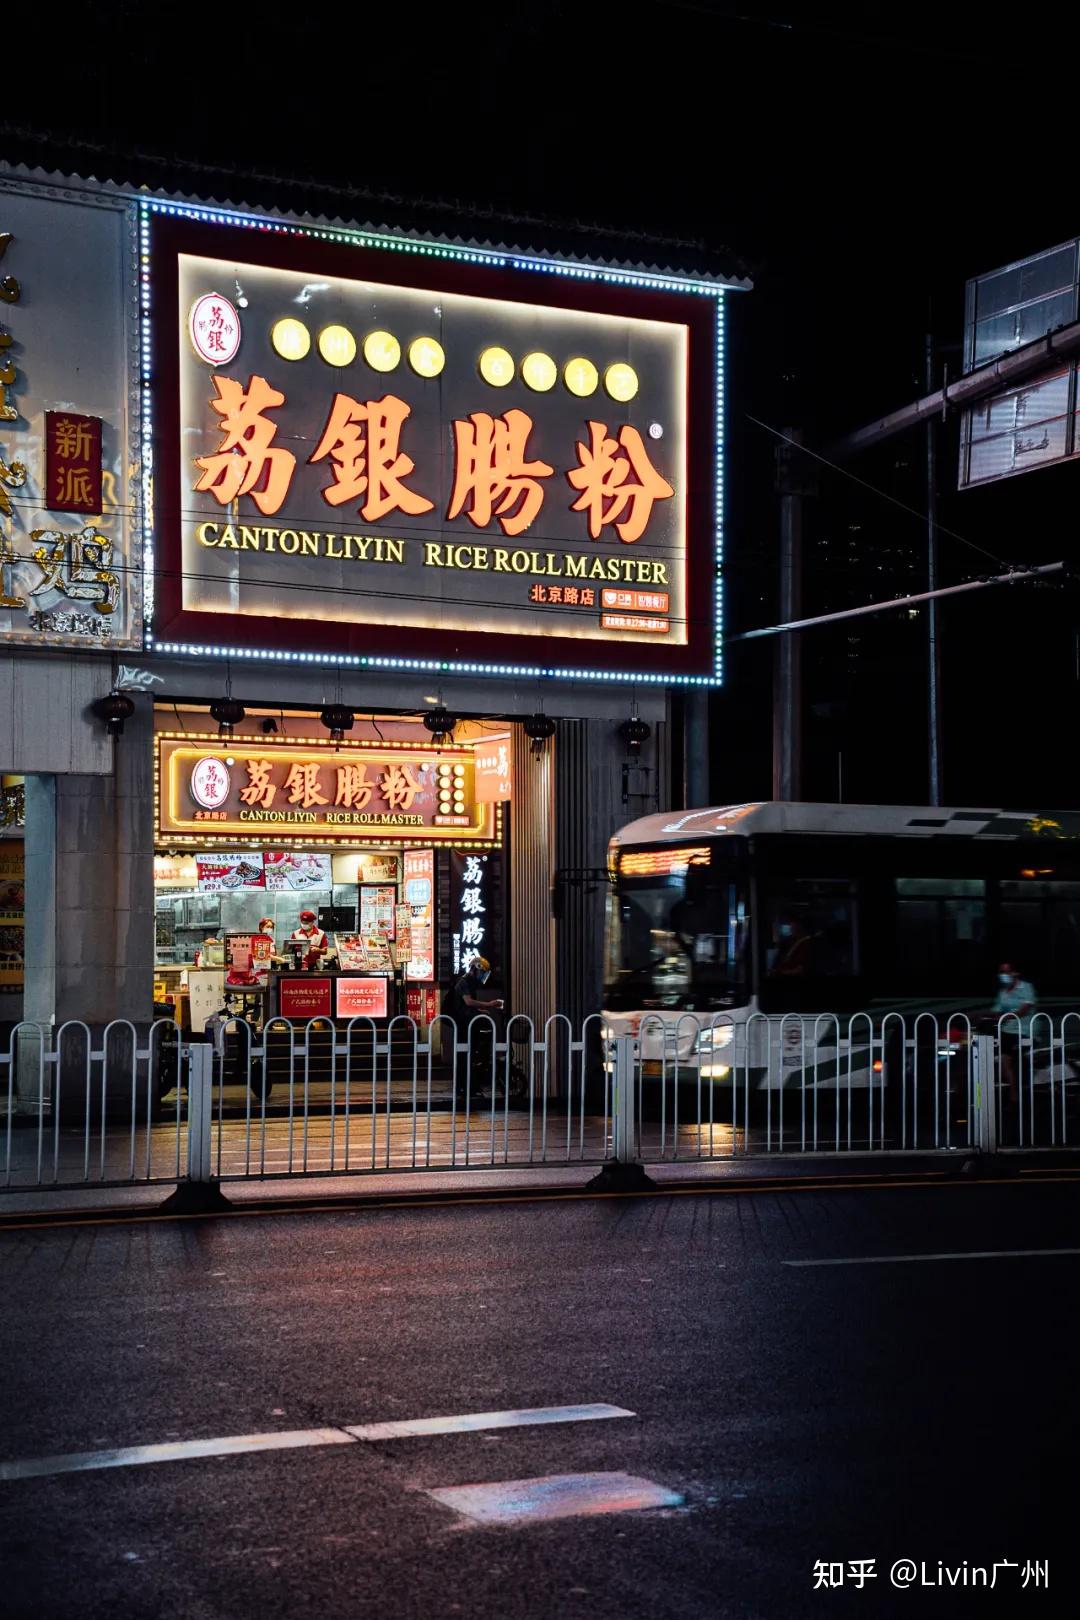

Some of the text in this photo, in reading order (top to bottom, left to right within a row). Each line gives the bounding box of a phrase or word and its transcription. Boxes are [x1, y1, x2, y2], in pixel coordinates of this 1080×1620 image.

[208, 306, 227, 352] 荔銀
[56, 418, 95, 506] 新派
[193, 373, 675, 544] 荔銀腸粉
[197, 522, 669, 584] CANTON LIYIN RICE ROLL MASTER
[531, 584, 595, 606] 北京路店
[204, 766, 219, 798] 荔銀
[240, 760, 425, 810] 荔銀腸粉
[239, 810, 286, 821] CANTON
[287, 811, 317, 823] LIYIN
[326, 812, 352, 823] RICE
[353, 813, 381, 824] ROLL
[381, 814, 424, 825] MASTER
